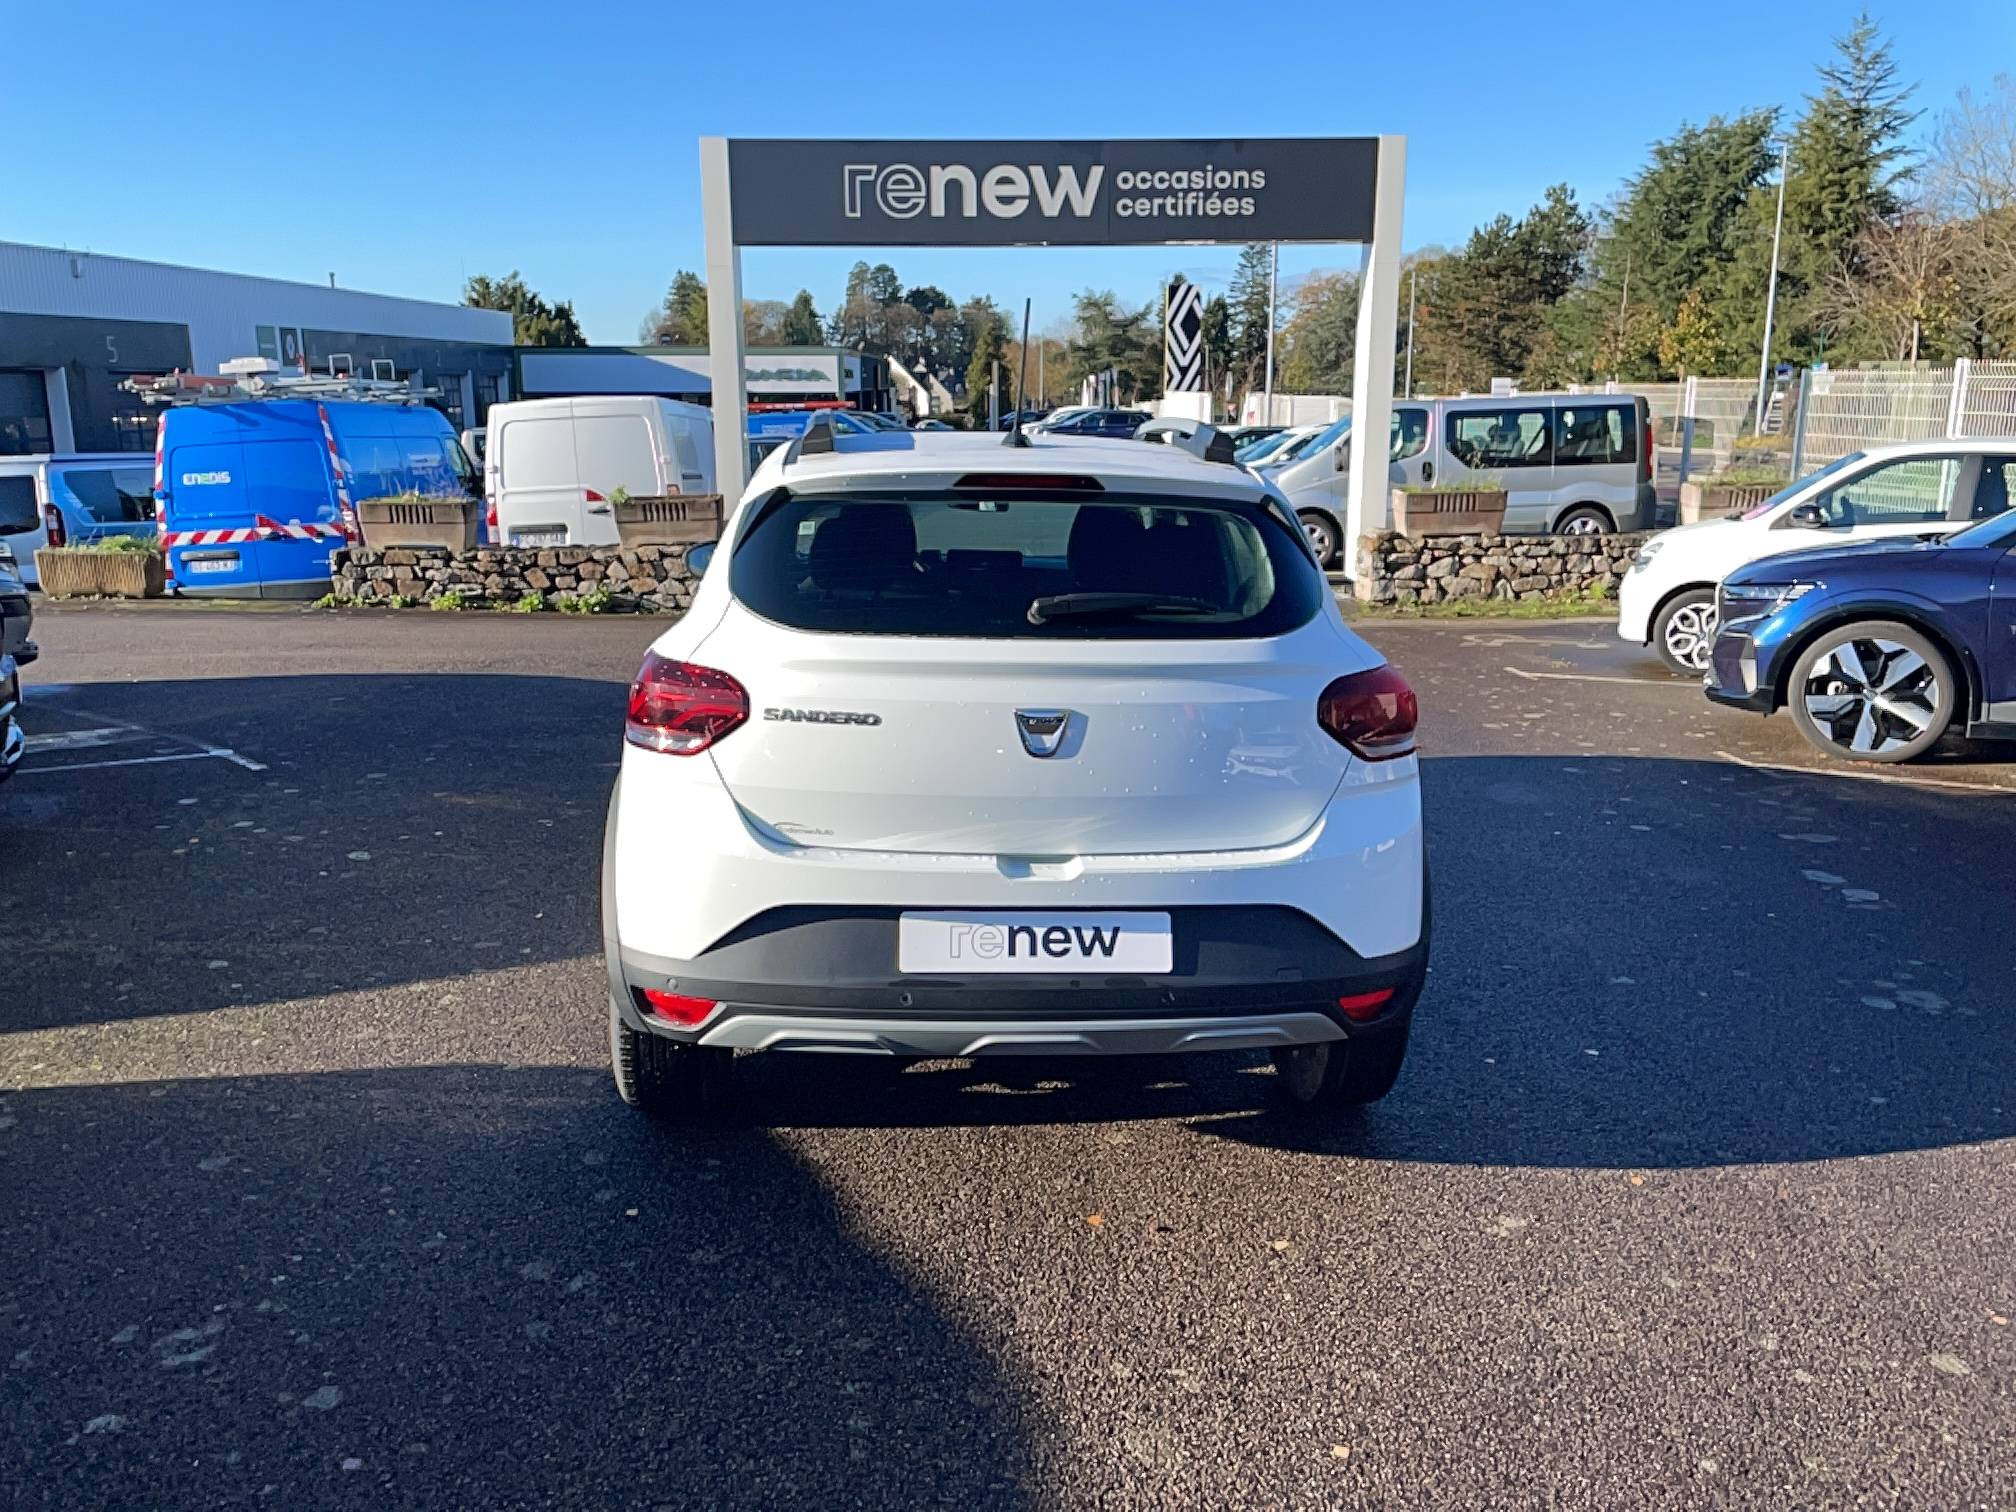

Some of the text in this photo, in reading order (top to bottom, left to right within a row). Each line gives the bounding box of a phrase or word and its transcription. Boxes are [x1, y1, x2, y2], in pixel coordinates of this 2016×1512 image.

[843, 163, 1105, 218] renew
[1116, 165, 1266, 190] occasions
[1116, 192, 1256, 217] certifiées
[106, 336, 119, 364] 5
[763, 707, 882, 726] SANDERO
[949, 923, 1120, 959] renew
